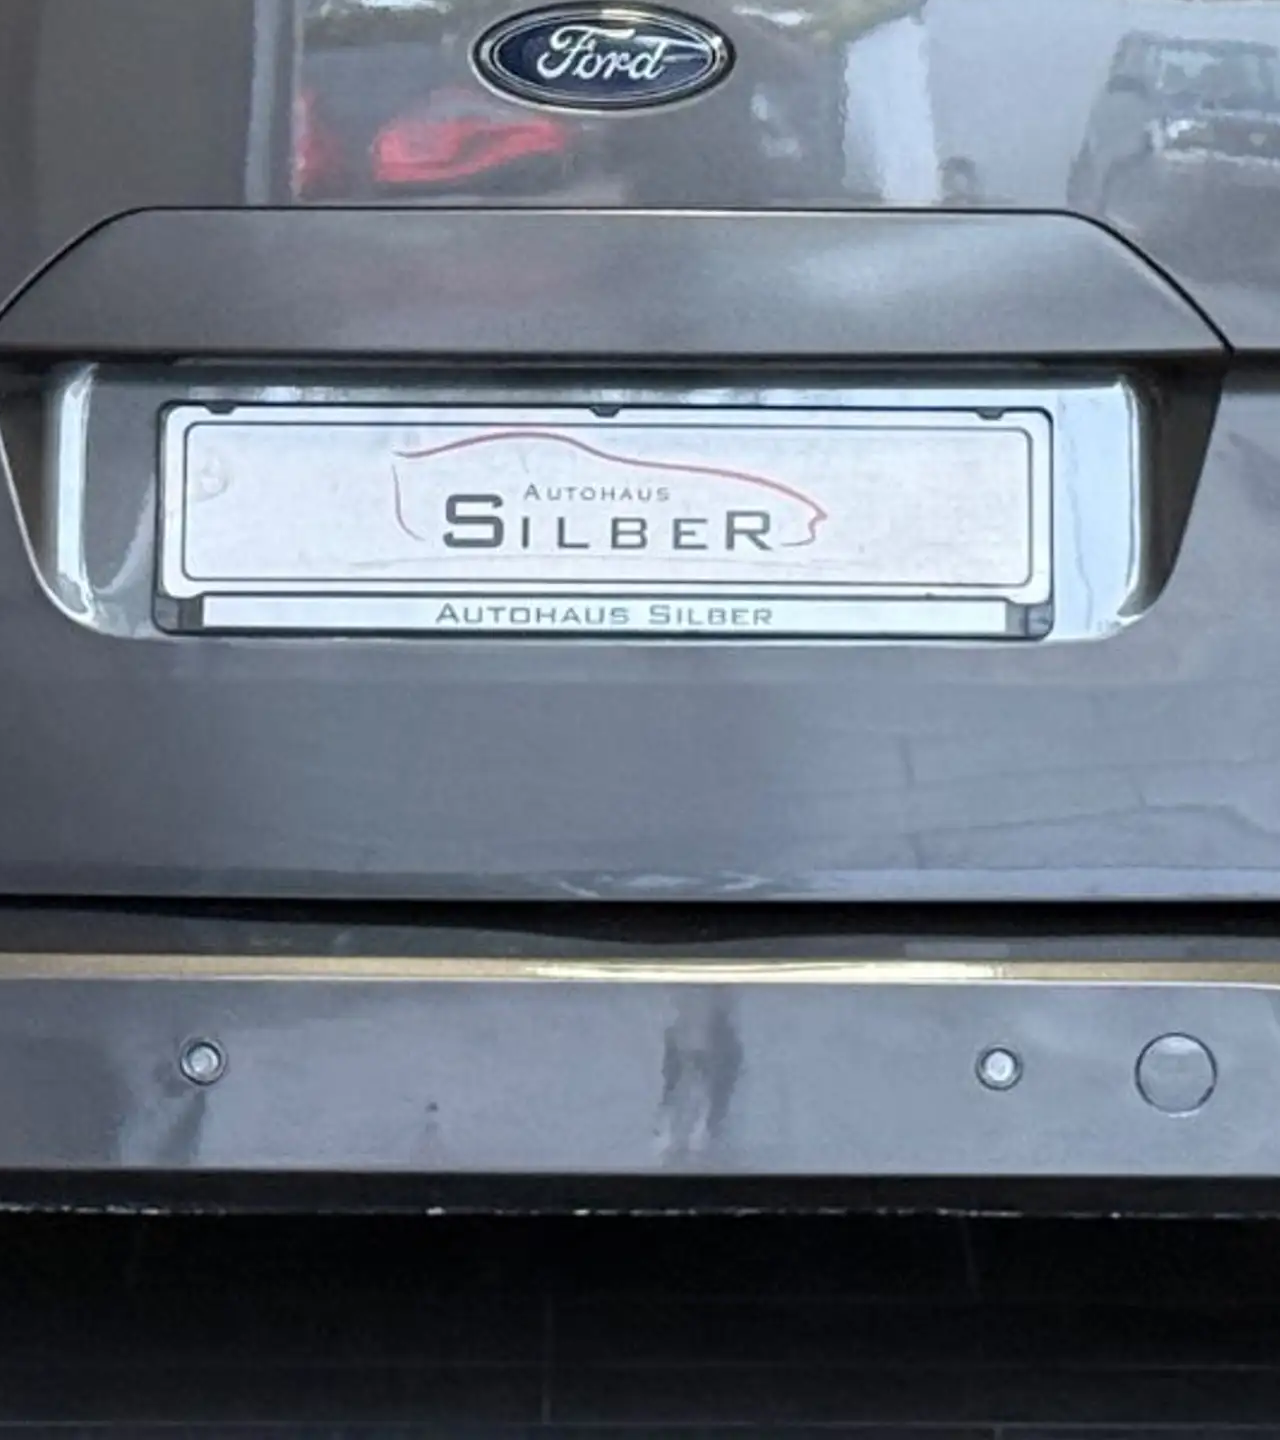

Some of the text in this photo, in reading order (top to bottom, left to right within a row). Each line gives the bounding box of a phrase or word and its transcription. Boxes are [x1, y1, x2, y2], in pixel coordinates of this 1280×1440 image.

[536, 25, 668, 80] Ford
[523, 483, 671, 502] AUTOHAUS
[442, 493, 773, 551] SILBER
[435, 603, 774, 626] AUTOHAUS SILBER
